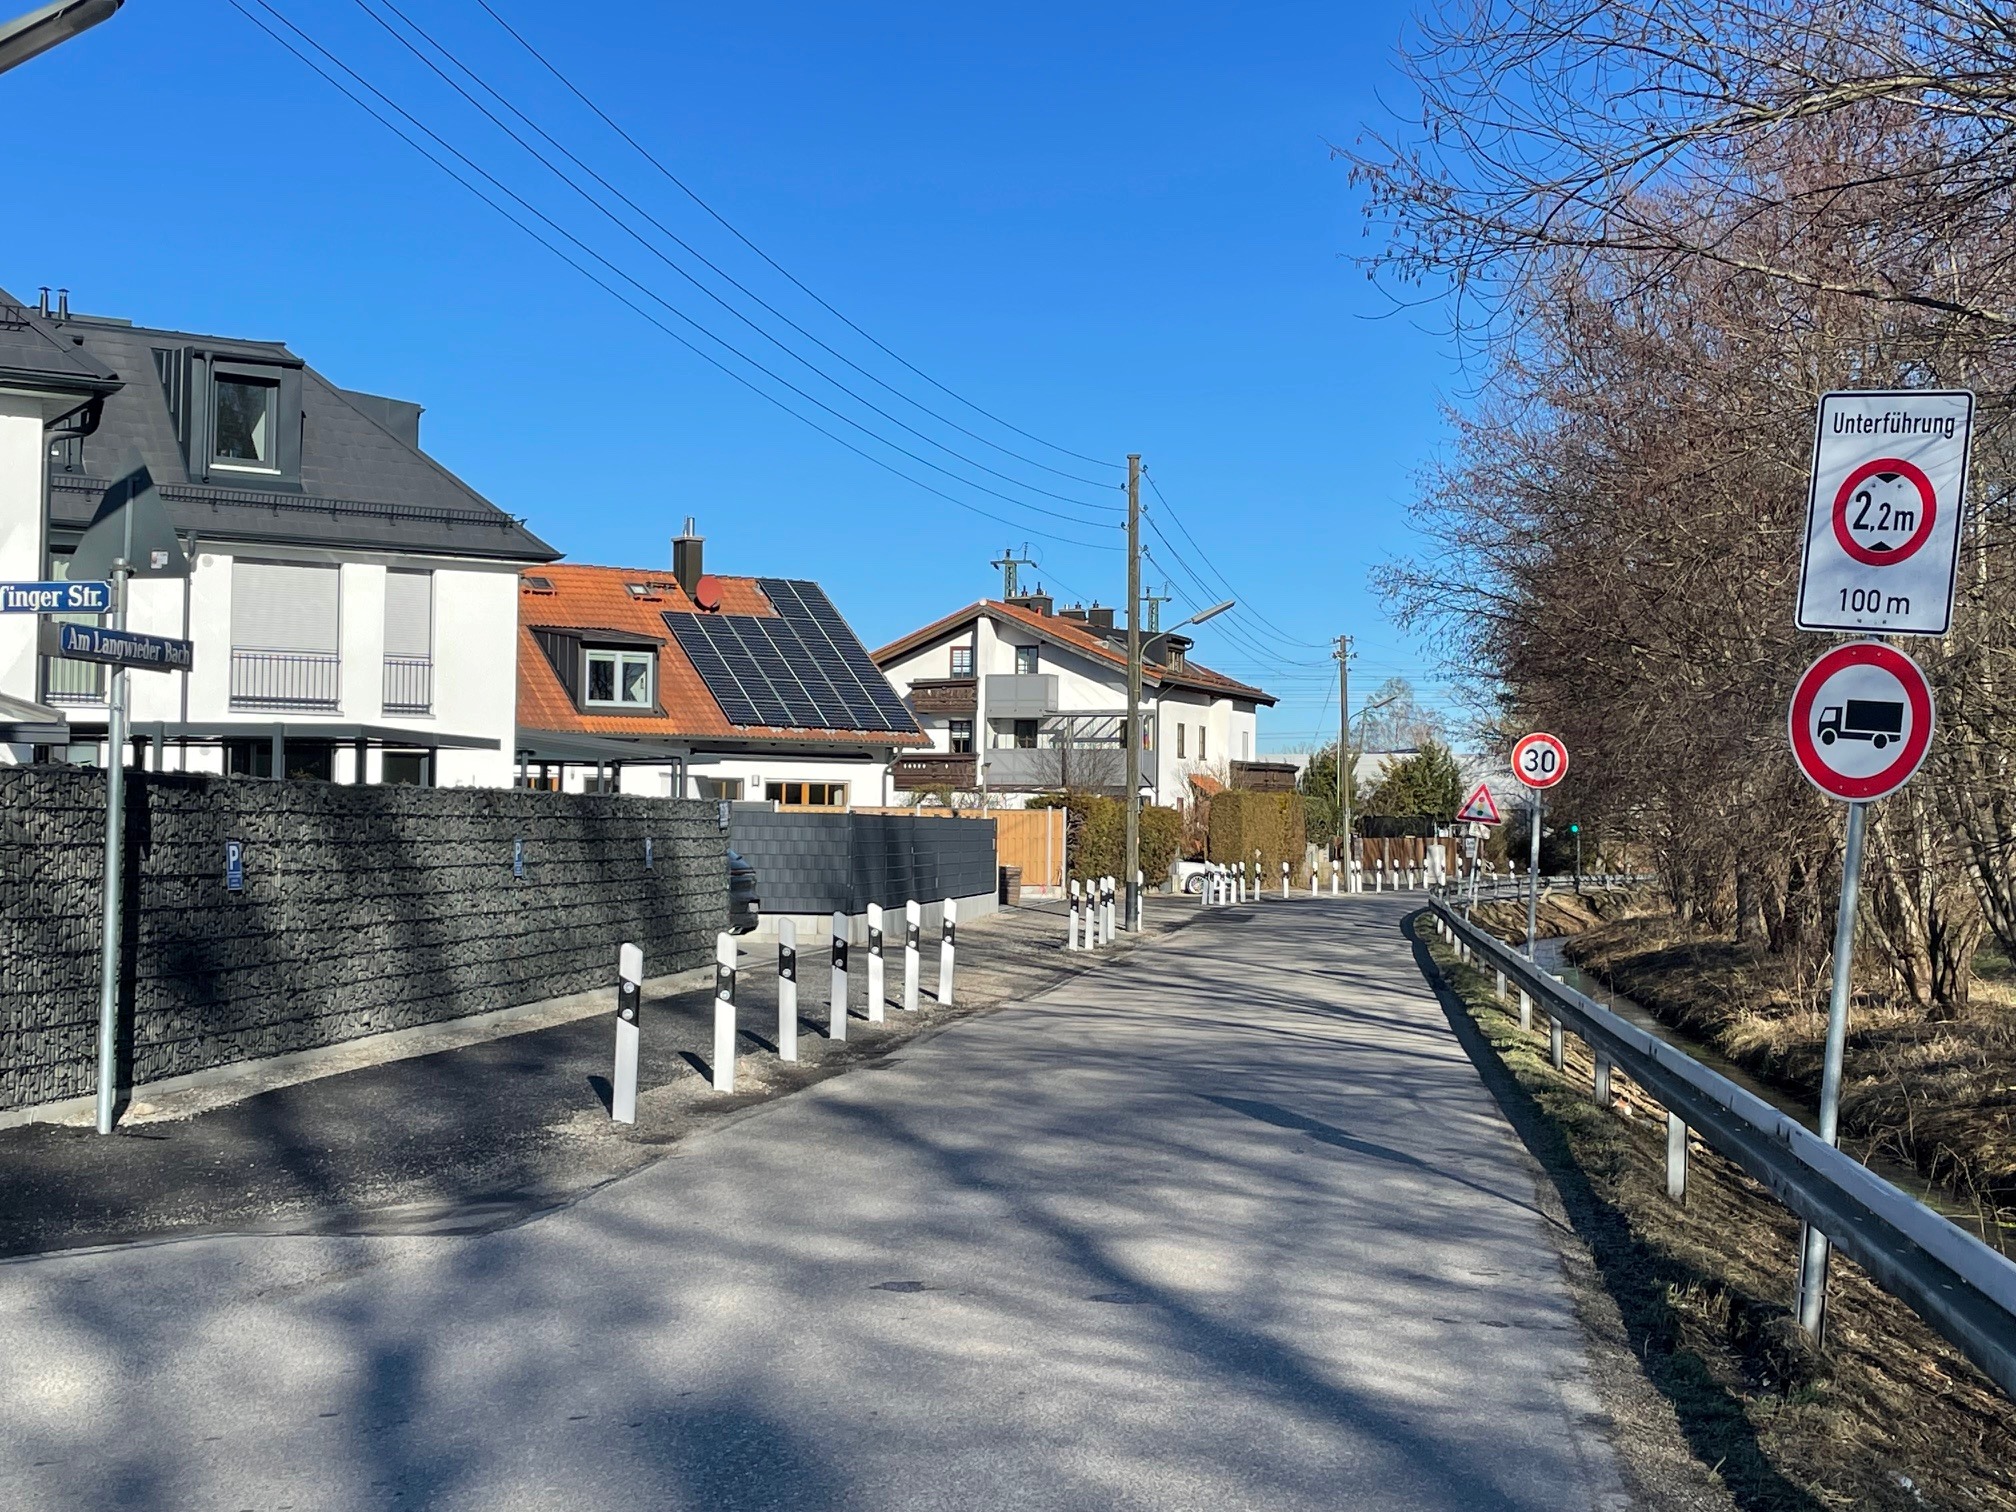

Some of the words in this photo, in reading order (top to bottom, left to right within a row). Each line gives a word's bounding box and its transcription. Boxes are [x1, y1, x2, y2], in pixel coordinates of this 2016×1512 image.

[1833, 411, 1956, 440] Unterführung
[68, 584, 103, 607] Str.
[1840, 588, 1881, 613] 100
[1886, 596, 1910, 615] m
[67, 626, 91, 652] Am
[93, 630, 162, 661] Langwieder
[164, 640, 190, 665] Bach
[1525, 748, 1556, 773] 30
[228, 845, 239, 871] P
[515, 842, 522, 861] P
